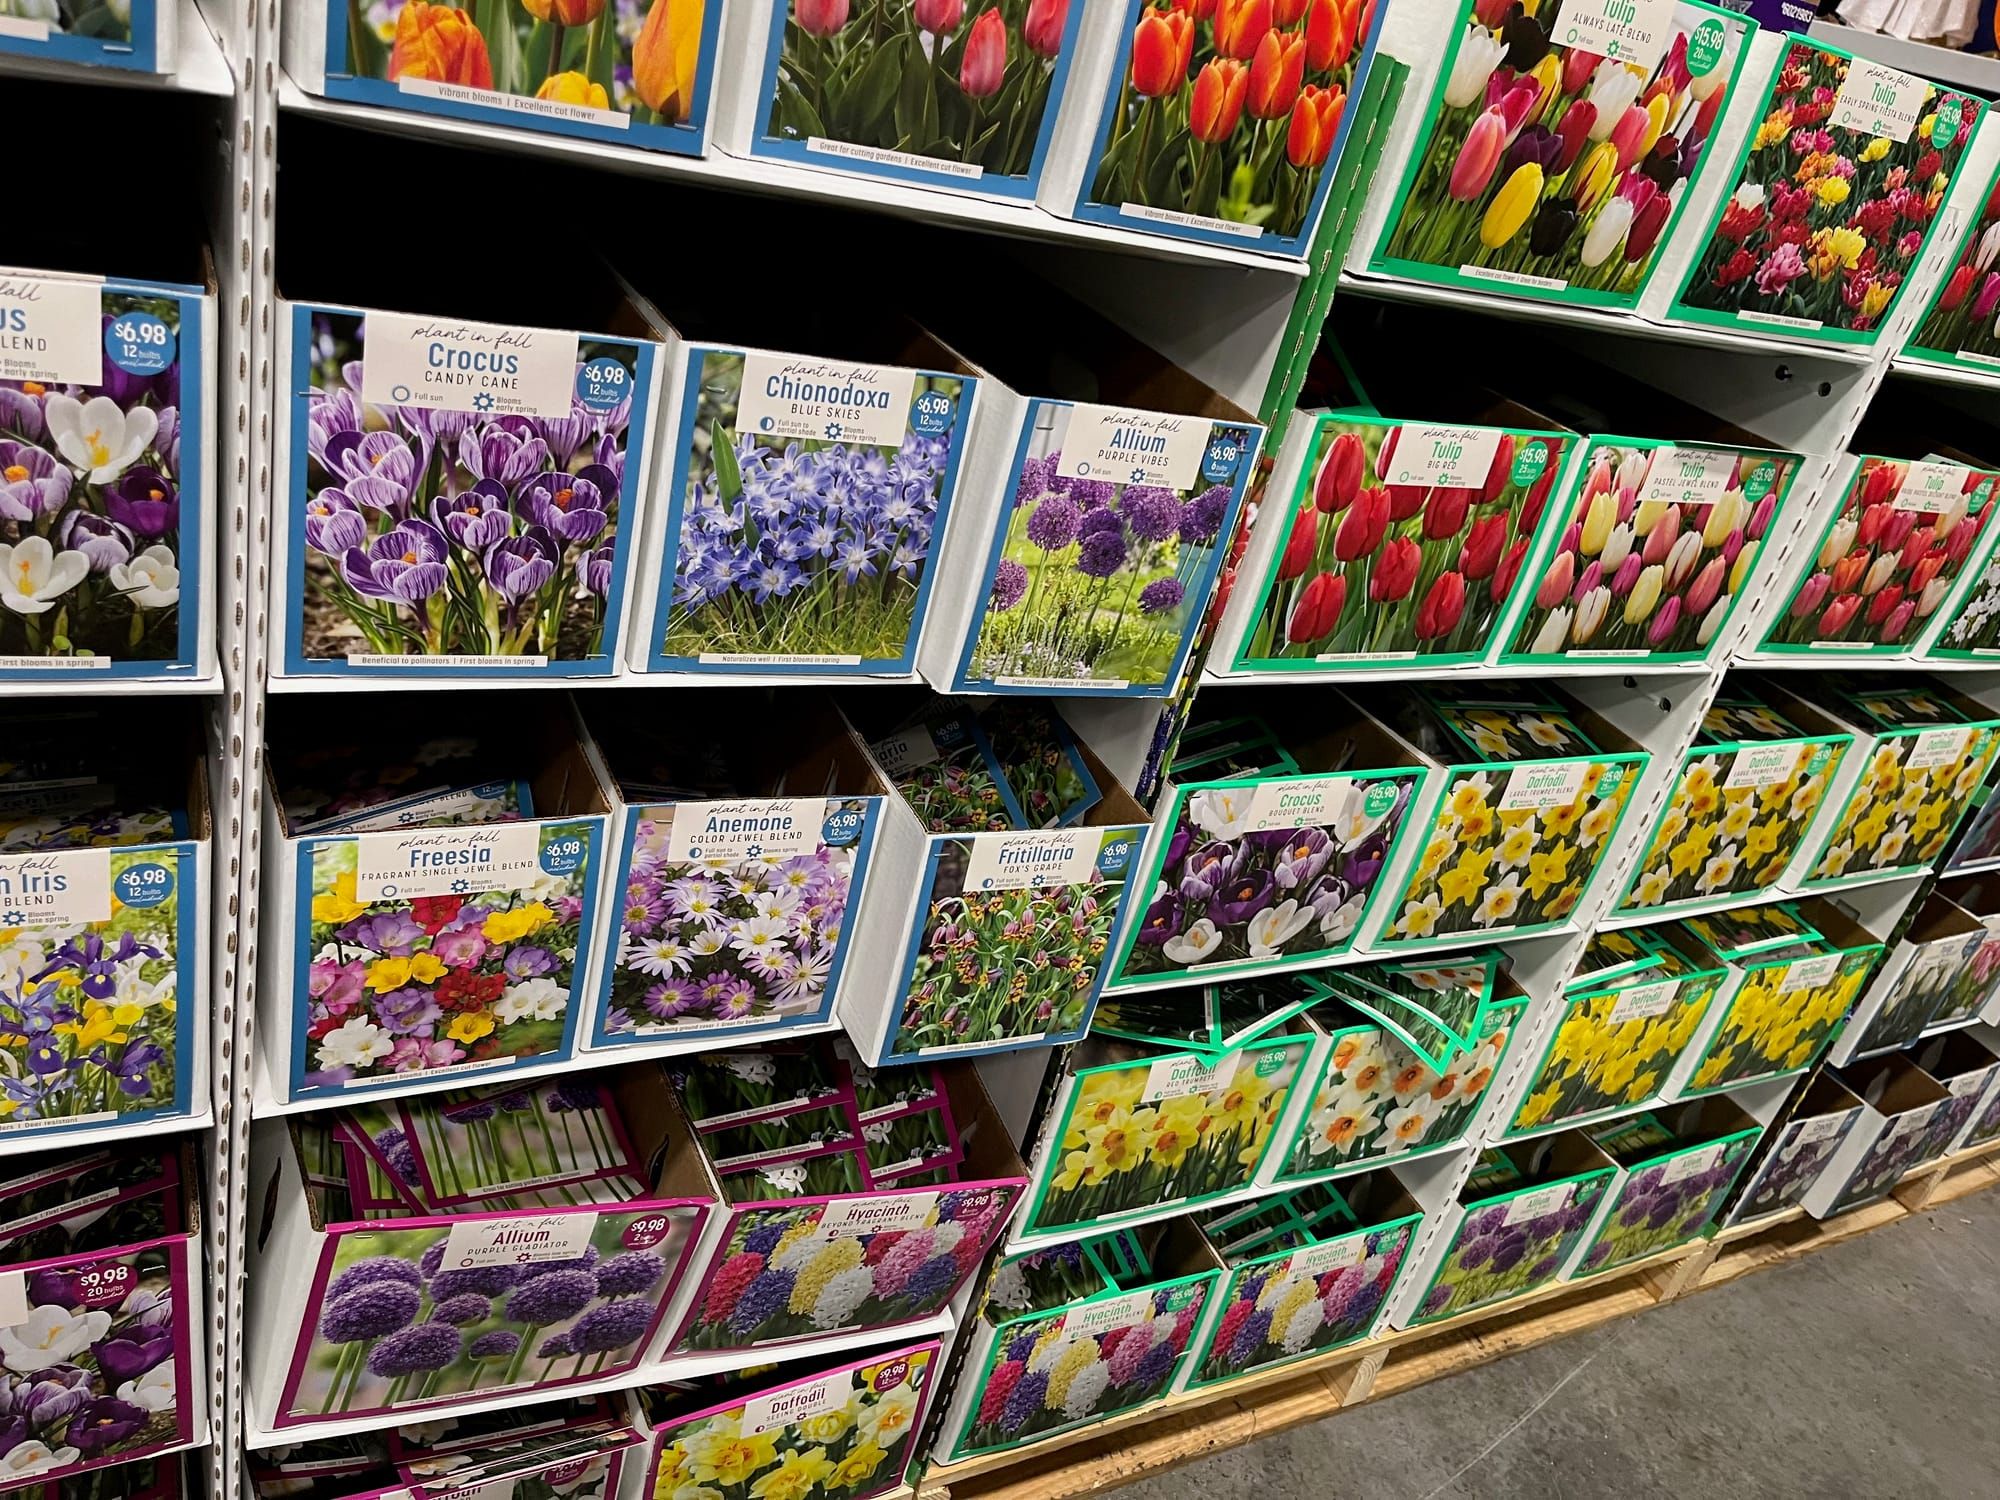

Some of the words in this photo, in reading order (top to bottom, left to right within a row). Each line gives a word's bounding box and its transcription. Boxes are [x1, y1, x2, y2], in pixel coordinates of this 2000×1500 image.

[1602, 0, 1635, 24] Tulip
[1573, 13, 1604, 30] ALWAYS
[1606, 21, 1624, 36] LATE
[1627, 28, 1652, 43] BLEND
[1695, 27, 1724, 50] $15.98
[438, 86, 469, 99] Vibrant
[473, 92, 502, 105] blooms
[514, 99, 552, 113] Excellent
[555, 106, 567, 116] cut
[571, 108, 594, 120] flower
[1872, 83, 1897, 109] Tulip
[1840, 95, 1858, 106] EARLY
[1859, 101, 1878, 112] SPRING
[1879, 106, 1897, 117] FIESTA
[1898, 112, 1915, 124] BLEND
[1940, 106, 1961, 125] $15.98
[820, 143, 837, 151] Great
[840, 145, 849, 154] for
[851, 148, 874, 159] cutting
[876, 153, 901, 163] gardens
[911, 159, 938, 170] Excellent
[941, 163, 950, 171] cut
[952, 165, 972, 175] flower
[115, 322, 167, 345] $6.98
[411, 323, 467, 340] plant
[471, 332, 492, 344] in
[494, 332, 532, 350] fall
[123, 344, 137, 357] 12
[138, 351, 160, 360] bulbs
[428, 343, 519, 374] Crocus
[4, 358, 36, 369] Blooms
[5, 369, 28, 378] early
[30, 370, 59, 380] spring
[425, 371, 474, 386] CANDY
[481, 376, 519, 390] CANE
[585, 365, 624, 385] $6.98
[414, 392, 428, 401] Full
[496, 396, 522, 405] Blooms
[766, 376, 890, 409] Chionodoxa
[496, 403, 515, 412] early
[518, 405, 537, 414] spring
[791, 403, 821, 416] BLUE
[826, 408, 861, 420] SKIES
[918, 398, 949, 415] $6.98
[777, 427, 797, 435] partial
[799, 428, 816, 436] shade
[842, 432, 858, 440] early
[860, 434, 877, 443] spring
[844, 426, 865, 434] Blooms
[1110, 428, 1166, 453] Allium
[1098, 449, 1136, 463] PURPLE
[1141, 454, 1169, 467] VIBES
[1209, 446, 1236, 462] $6.98
[1432, 442, 1463, 465] Tulip
[1519, 448, 1548, 463] $15.98
[1428, 461, 1440, 469] BIG
[1518, 464, 1527, 474] 25
[1680, 462, 1705, 482] Tulip
[1654, 478, 1675, 487] PASTEL
[1678, 478, 1697, 487] JEWEL
[1700, 480, 1719, 488] BLEND
[1925, 476, 1944, 492] Tulip
[1749, 755, 1783, 769] Daffodil
[1527, 773, 1567, 789] Daffodil
[1369, 786, 1396, 799] $15.98
[1530, 788, 1554, 796] TRUMPET
[1280, 794, 1322, 808] Crocus
[1269, 807, 1301, 817] BOUQUET
[1303, 806, 1325, 814] BLEND
[705, 816, 792, 832] Anemone
[829, 815, 857, 828] $6.98
[690, 834, 725, 843] COLOR
[730, 833, 765, 843] JEWEL
[770, 832, 803, 840] BLEND
[410, 845, 491, 868] Freesia
[546, 841, 579, 856] $6.98
[999, 844, 1075, 864] Fritillaria
[1104, 844, 1128, 856] $6.98
[18, 856, 59, 873] fall
[362, 871, 417, 881] FRAGRANT
[422, 867, 459, 877] SINGLE
[464, 864, 497, 873] JEWEL
[502, 861, 533, 870] BLEND
[1004, 865, 1030, 873] FOX'S
[1034, 863, 1062, 871] GRAPE
[23, 872, 67, 893] Iris
[122, 870, 166, 885] $6.98
[130, 888, 141, 897] 12
[4, 895, 54, 907] BLEND
[45, 915, 69, 923] spring
[1260, 1051, 1286, 1064] $15.98
[370, 1075, 398, 1084] Fragrant
[399, 1072, 422, 1080] blooms
[430, 1066, 459, 1076] Excellent
[472, 1061, 491, 1069] flower
[1166, 1080, 1179, 1088] RED
[1182, 1074, 1215, 1085] TRUMPETS
[44, 1118, 78, 1126] resistant
[961, 1196, 989, 1207] $9.98
[847, 1204, 910, 1221] Hyacinth
[631, 1219, 666, 1232] $9.98
[821, 1221, 853, 1229] BEYOND
[856, 1216, 898, 1225] FRAGRANT
[901, 1213, 925, 1221] BLEND
[492, 1228, 550, 1246] Allium
[467, 1245, 509, 1255] PURPLE
[512, 1240, 569, 1251] GLADIATOR
[1306, 1247, 1347, 1264] Hyacinth
[80, 1266, 128, 1287] $9.98
[87, 1286, 103, 1297] 20
[104, 1285, 124, 1294] bulbs
[1083, 1303, 1132, 1323] Hyacinth
[1064, 1324, 1089, 1333] BEYOND
[879, 1364, 906, 1379] $9.98
[771, 1388, 825, 1414] Daffodil
[766, 1407, 795, 1422] SEEING
[797, 1400, 827, 1416] DOUBLE
